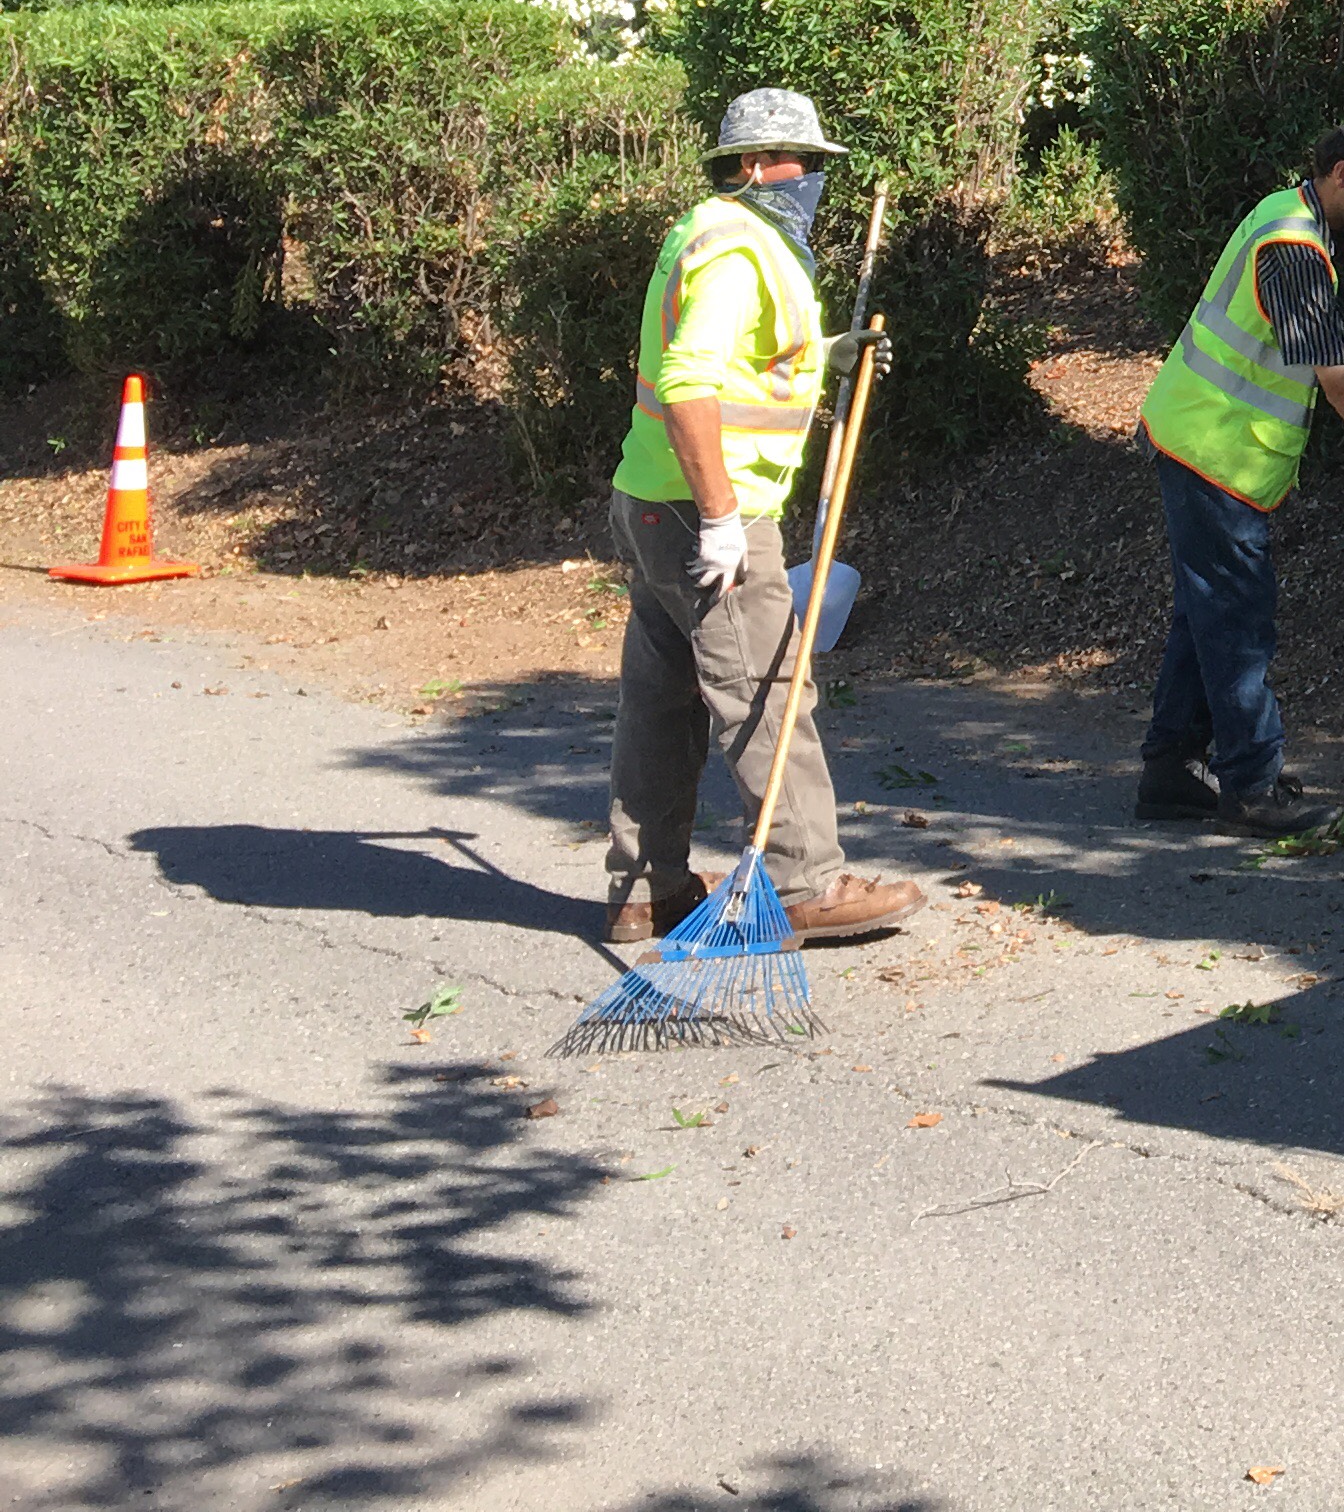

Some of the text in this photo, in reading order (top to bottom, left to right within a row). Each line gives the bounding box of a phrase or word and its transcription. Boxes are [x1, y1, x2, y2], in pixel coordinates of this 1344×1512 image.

[117, 520, 140, 533] CITY
[129, 533, 147, 544] SAN
[118, 544, 150, 558] RAFAE
